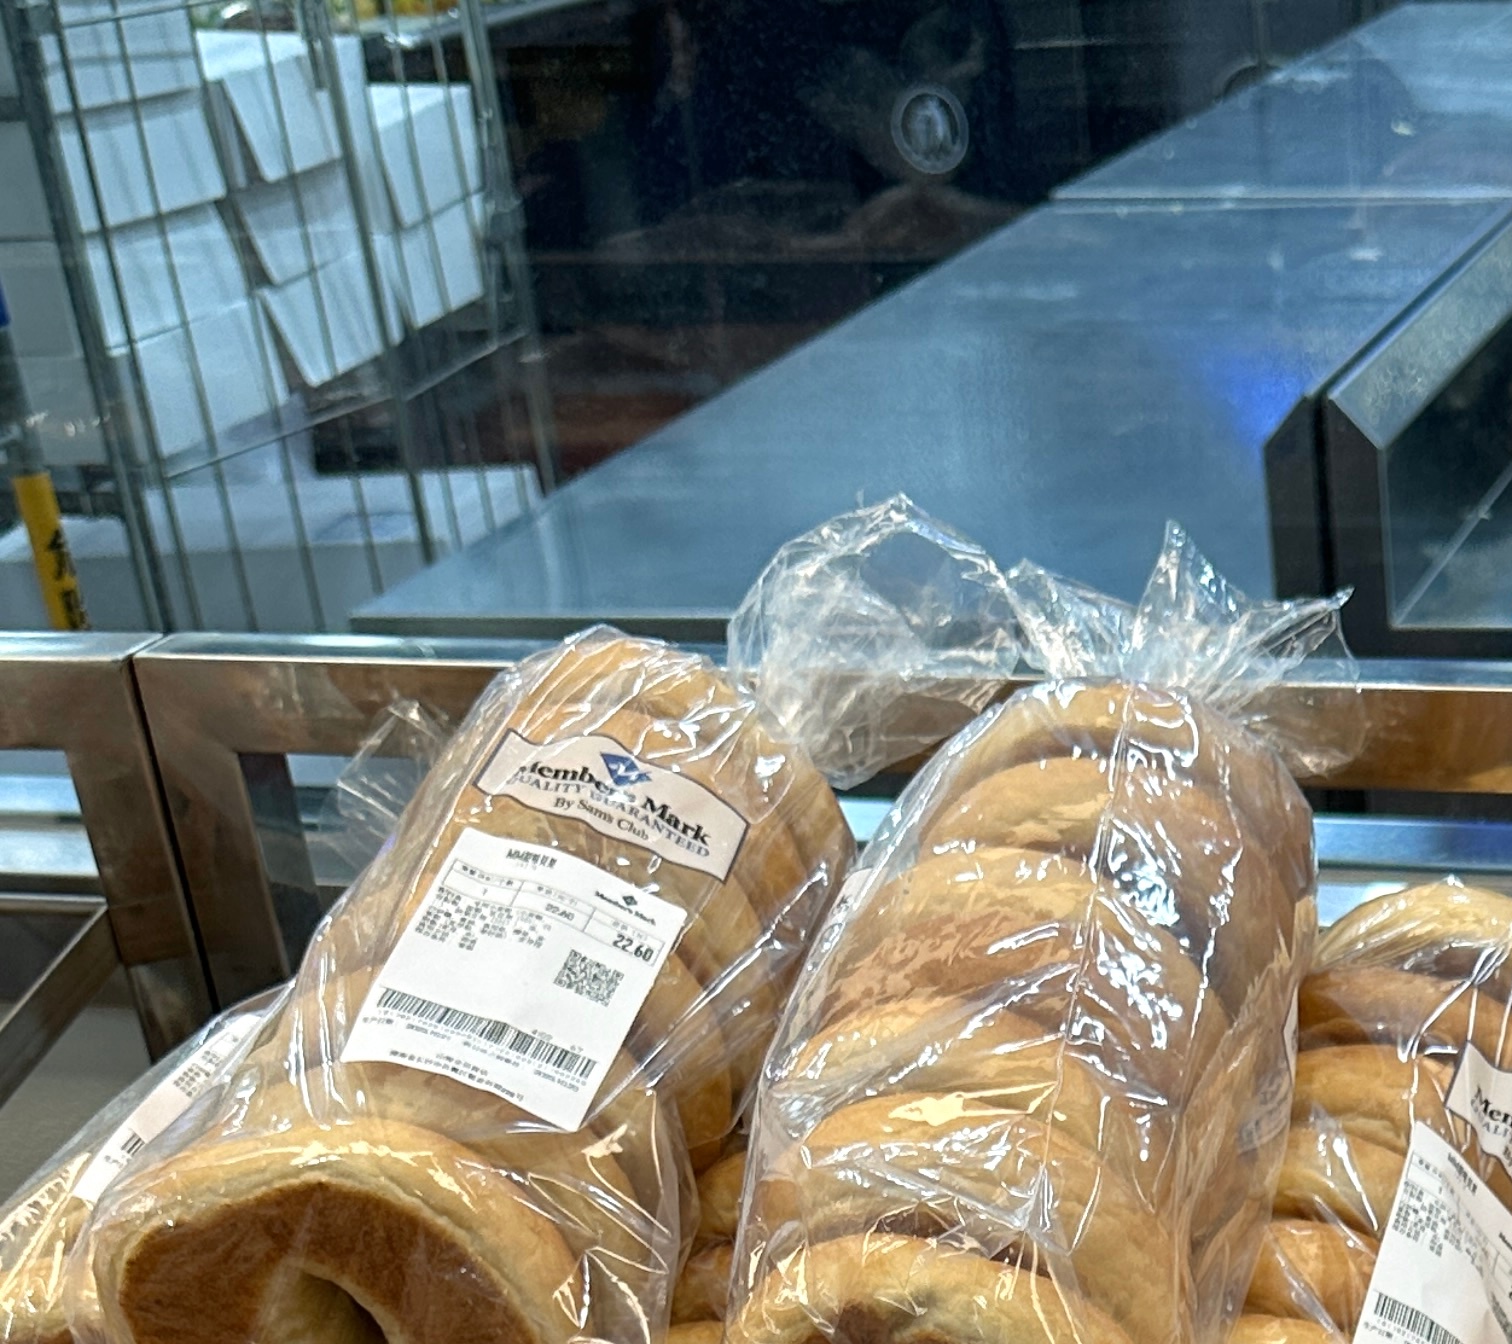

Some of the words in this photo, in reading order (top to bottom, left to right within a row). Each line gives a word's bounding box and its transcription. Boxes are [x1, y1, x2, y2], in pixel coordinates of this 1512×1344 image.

[554, 797, 573, 809] By
[577, 799, 613, 825] Sam's
[617, 819, 649, 841] Club
[642, 796, 712, 846] Mark
[612, 933, 654, 963] 22.60
